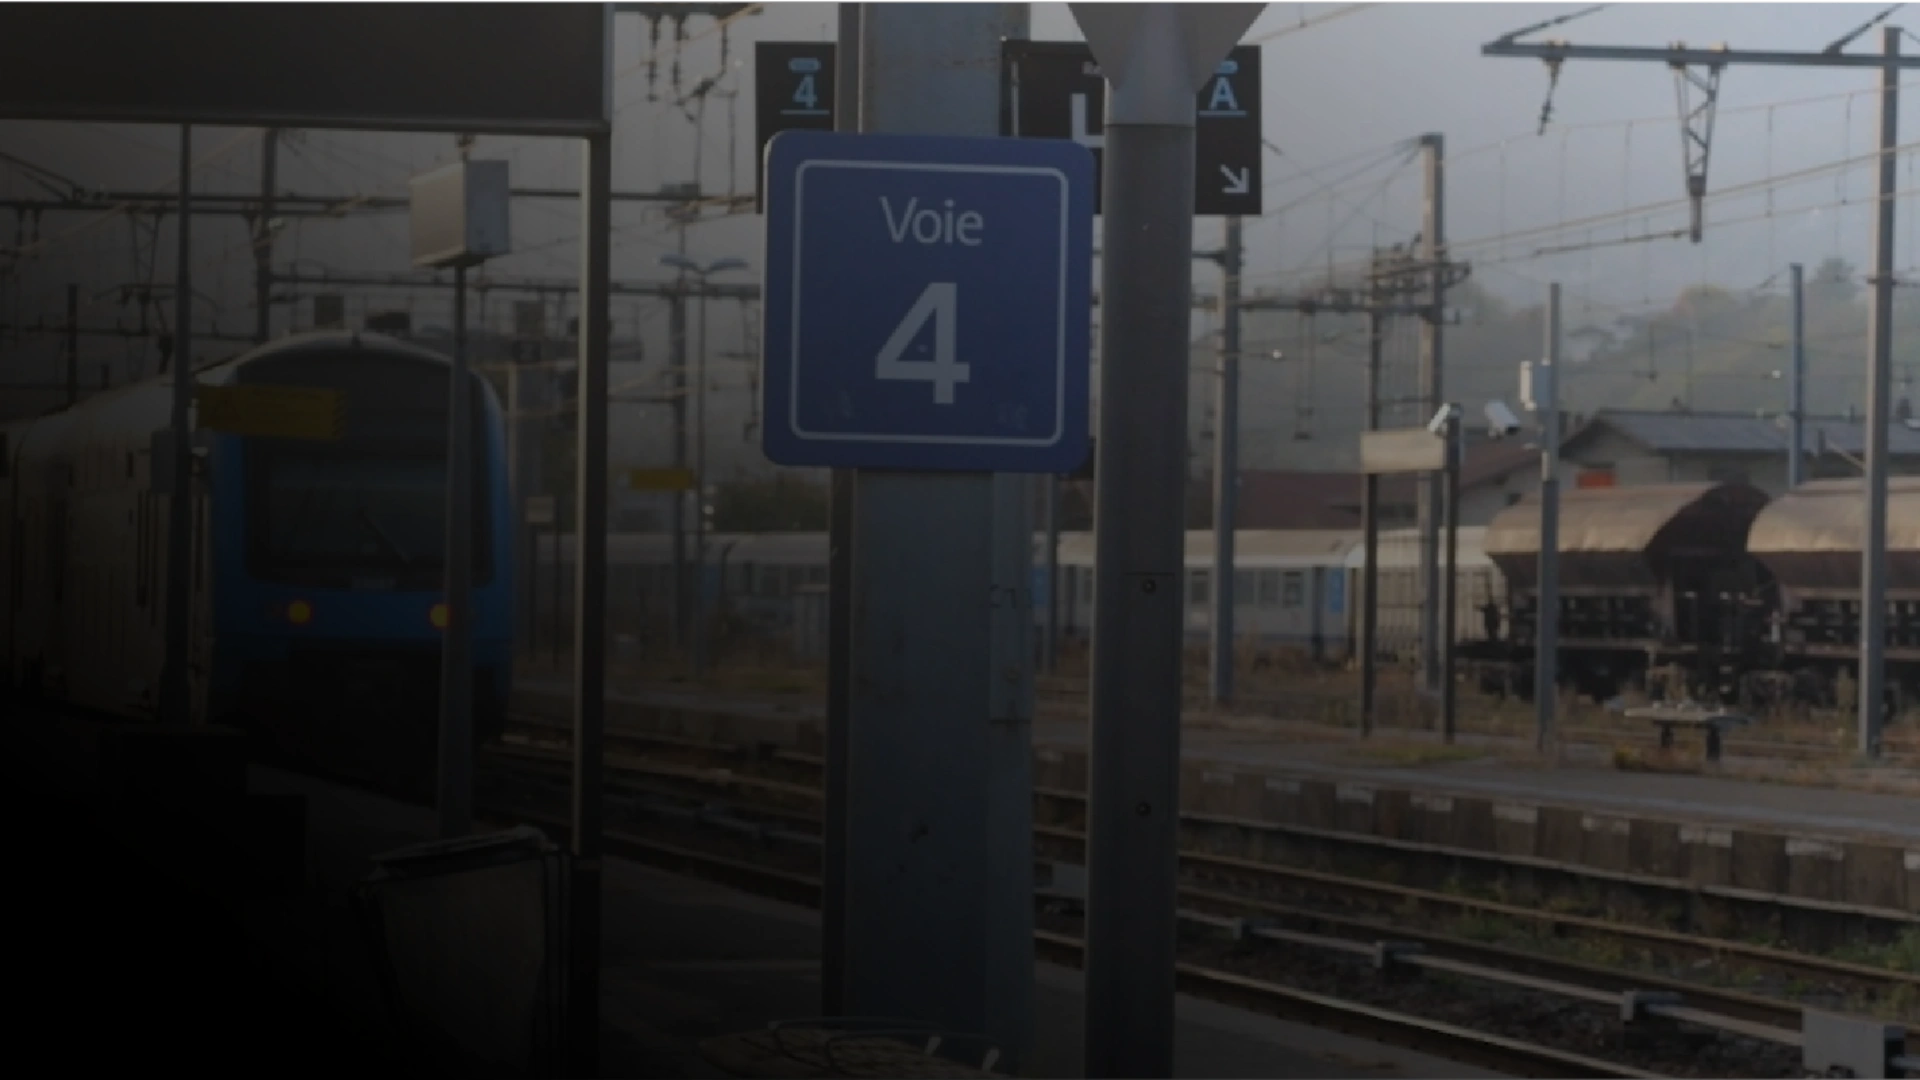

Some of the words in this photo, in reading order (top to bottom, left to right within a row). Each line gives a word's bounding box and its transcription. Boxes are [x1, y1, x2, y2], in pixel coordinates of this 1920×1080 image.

[792, 73, 818, 108] 4
[1207, 75, 1239, 110] A
[878, 195, 984, 247] Voie
[874, 281, 971, 405] 4
